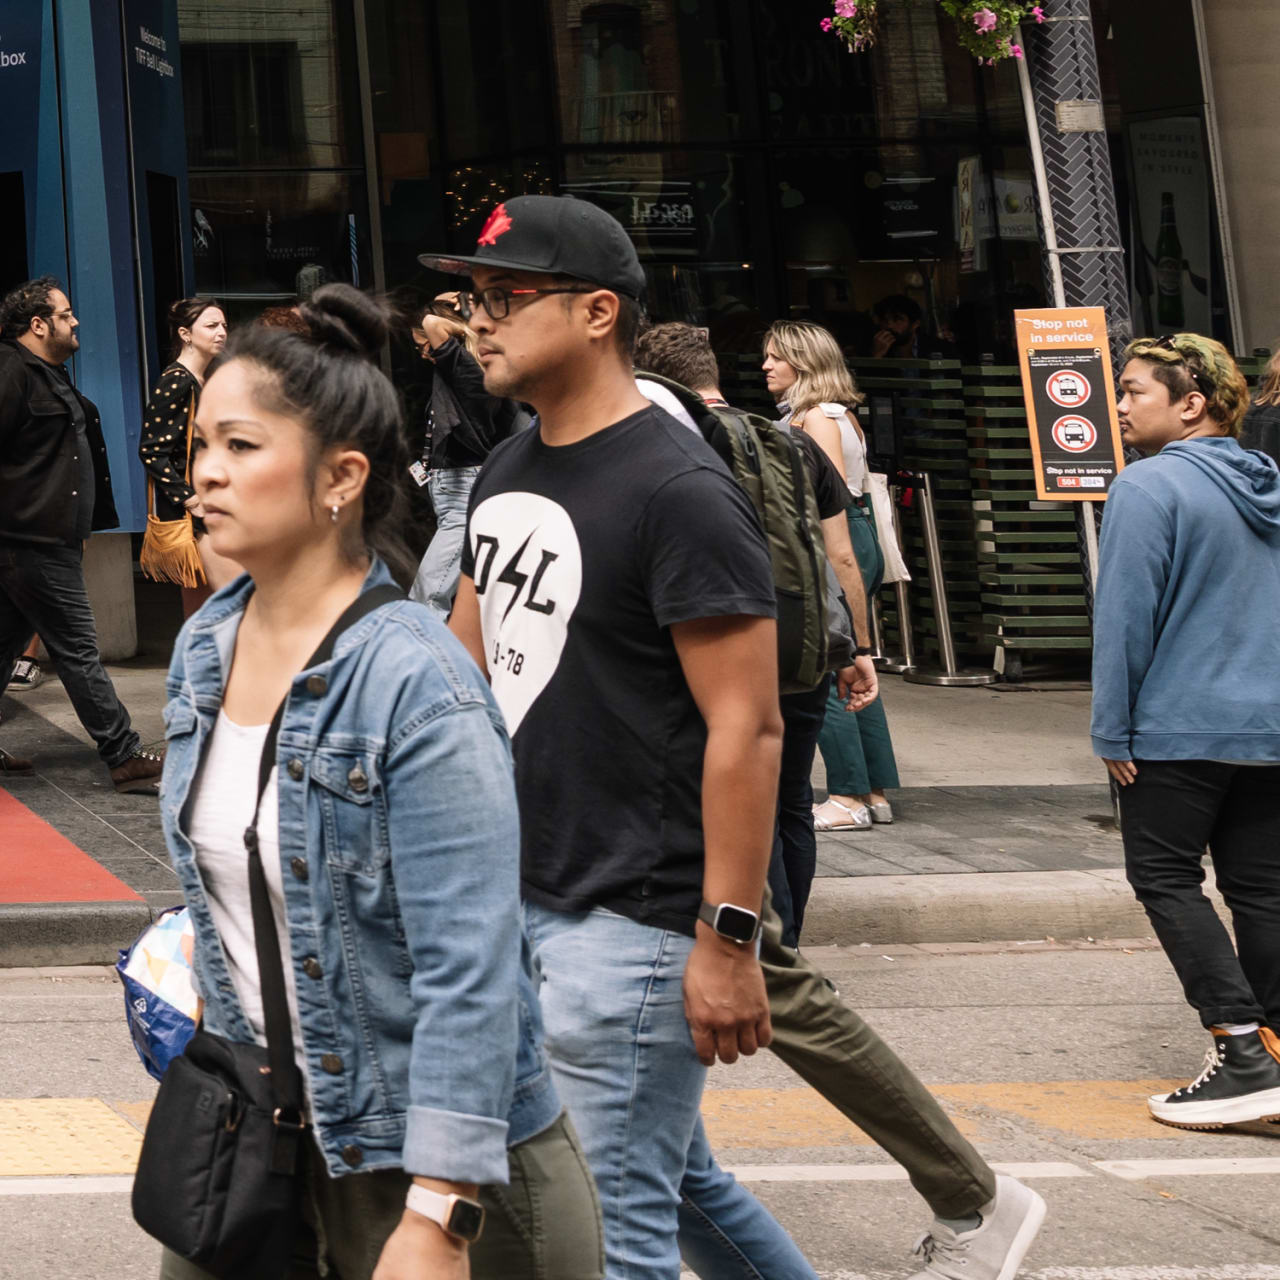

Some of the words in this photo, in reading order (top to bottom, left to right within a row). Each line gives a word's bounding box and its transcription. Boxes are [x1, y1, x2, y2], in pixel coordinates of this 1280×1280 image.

[1033, 318, 1063, 331] Stop
[1066, 318, 1088, 328] not
[1030, 333, 1043, 343] in
[1046, 333, 1094, 343] service
[1047, 467, 1063, 476] Stop
[1078, 467, 1085, 475] in
[1087, 467, 1112, 475] service
[1061, 478, 1076, 487] 504
